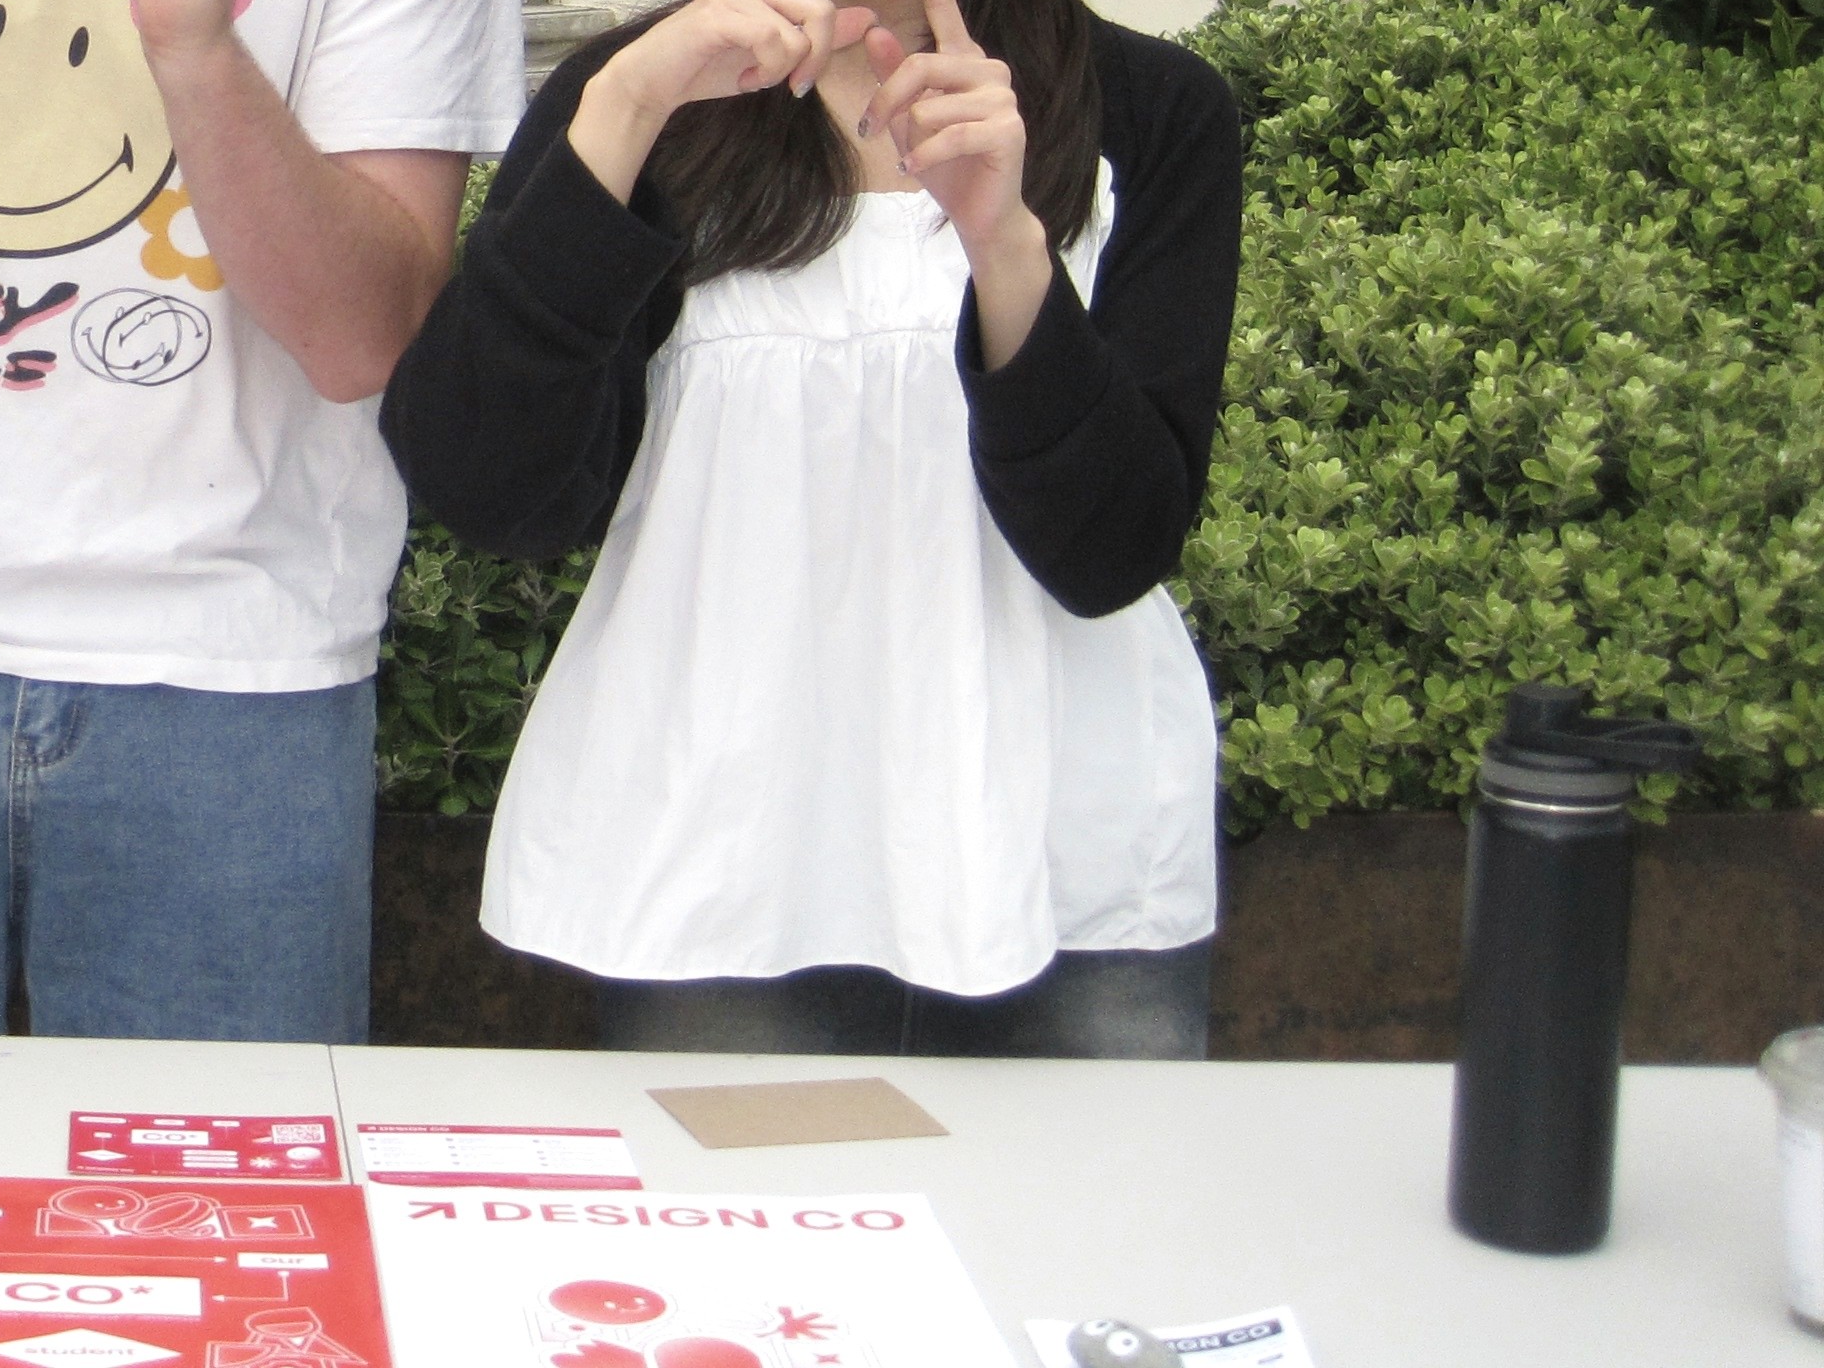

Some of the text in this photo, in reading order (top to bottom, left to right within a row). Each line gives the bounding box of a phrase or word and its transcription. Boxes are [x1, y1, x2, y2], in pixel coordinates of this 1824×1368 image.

[481, 1201, 905, 1230] DESIGN CO
[259, 1256, 306, 1265] our
[1226, 1324, 1270, 1344] CO
[23, 1344, 135, 1358] student
